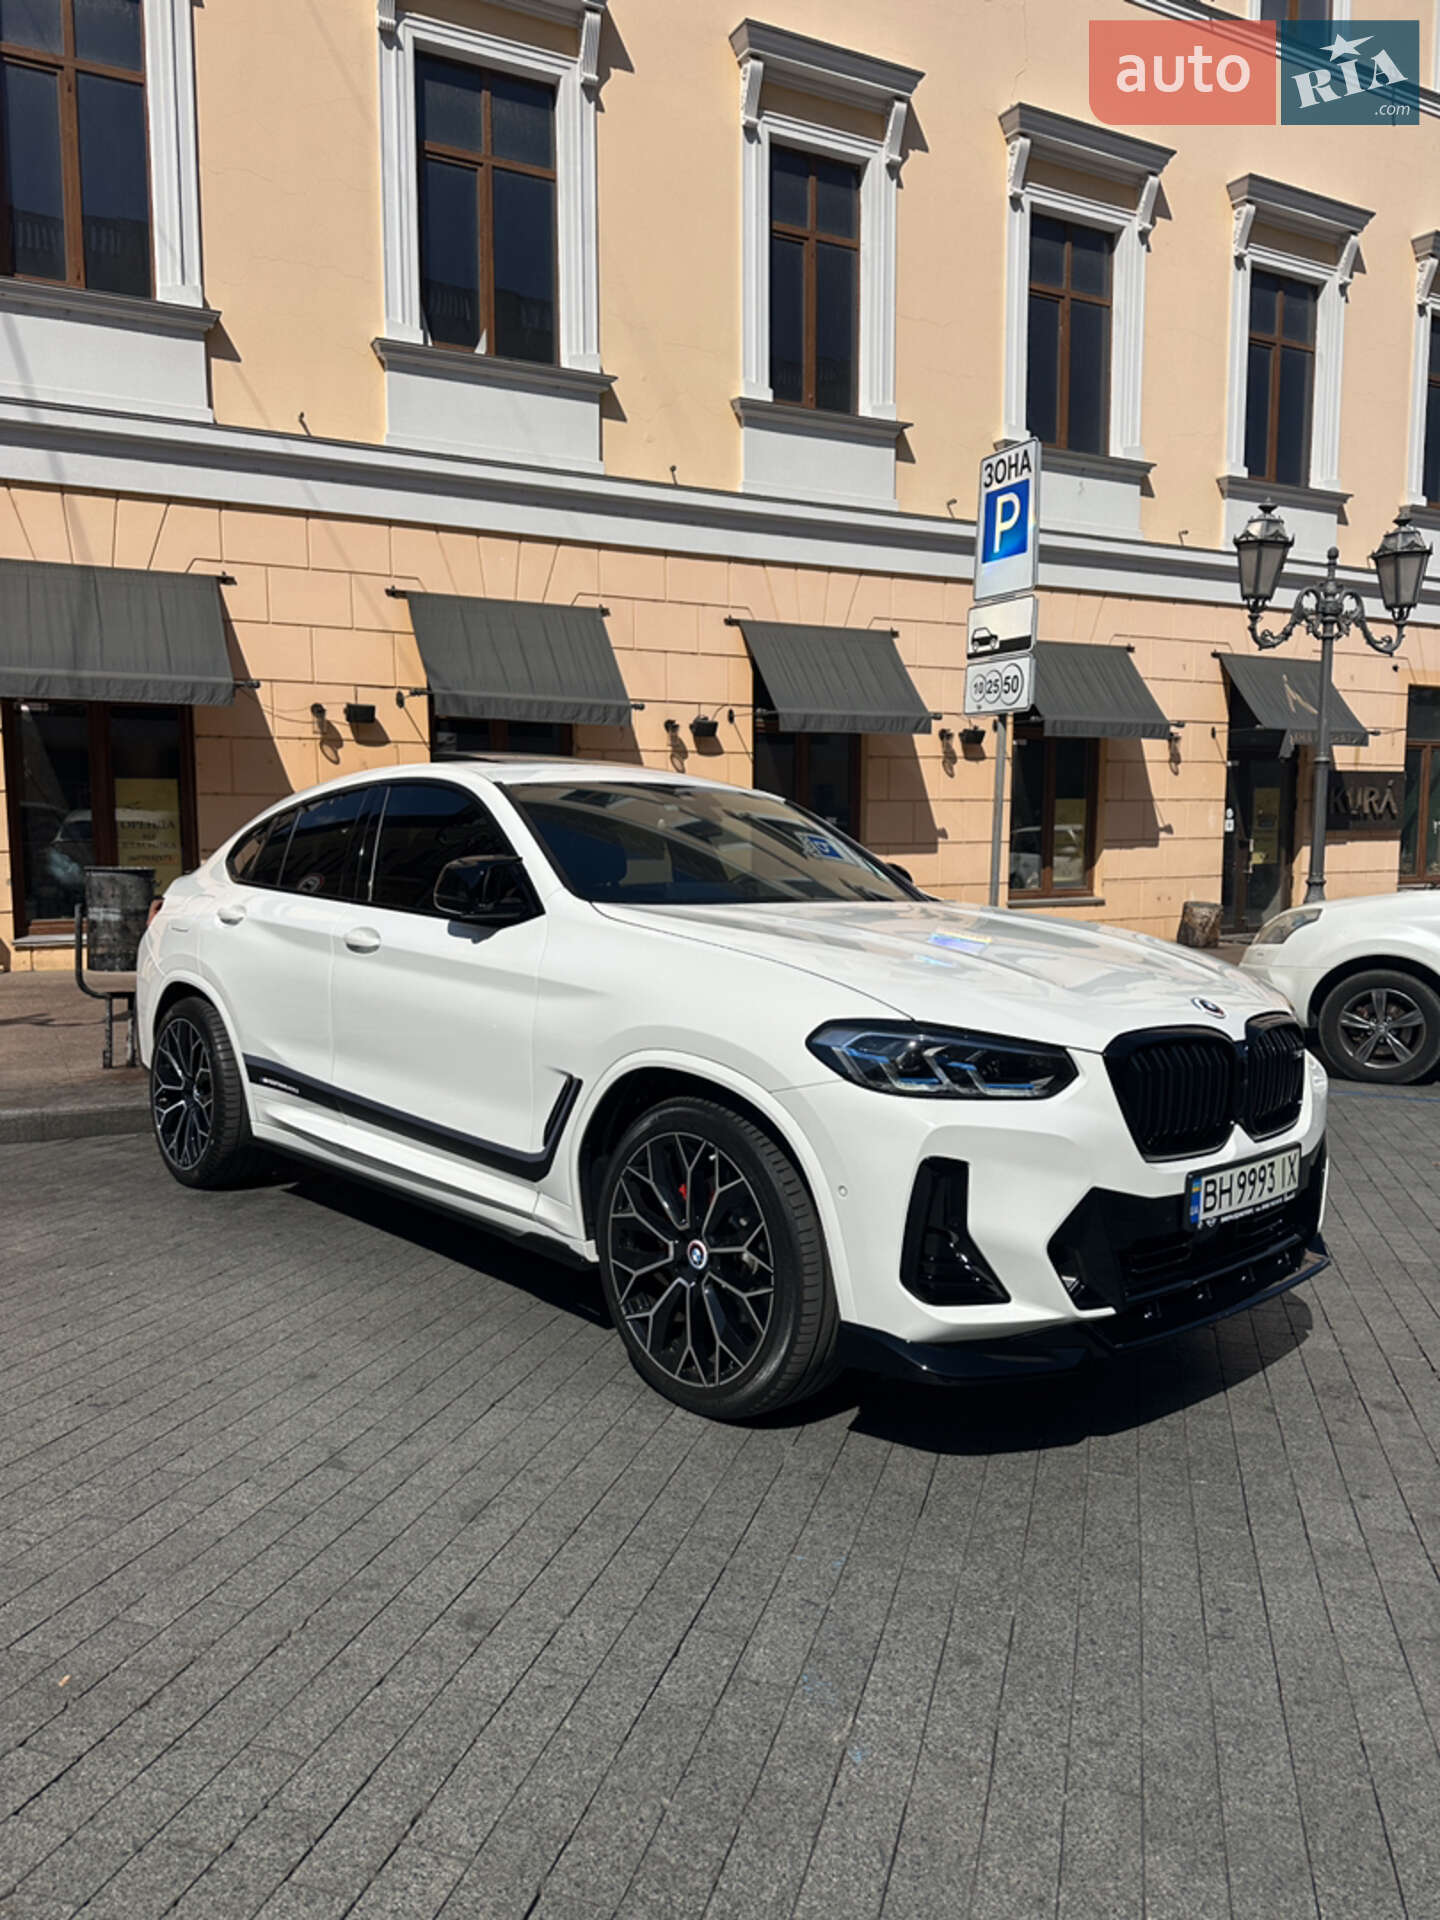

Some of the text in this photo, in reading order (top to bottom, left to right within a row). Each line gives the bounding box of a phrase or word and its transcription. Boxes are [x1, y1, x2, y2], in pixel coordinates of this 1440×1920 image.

[983, 449, 1032, 488] ЗОНА
[993, 492, 1020, 553] P
[986, 678, 1000, 694] 25
[1003, 674, 1019, 694] 50
[1203, 1174, 1234, 1213] BH
[1237, 1161, 1275, 1204] 9993
[1281, 1153, 1297, 1189] IX
